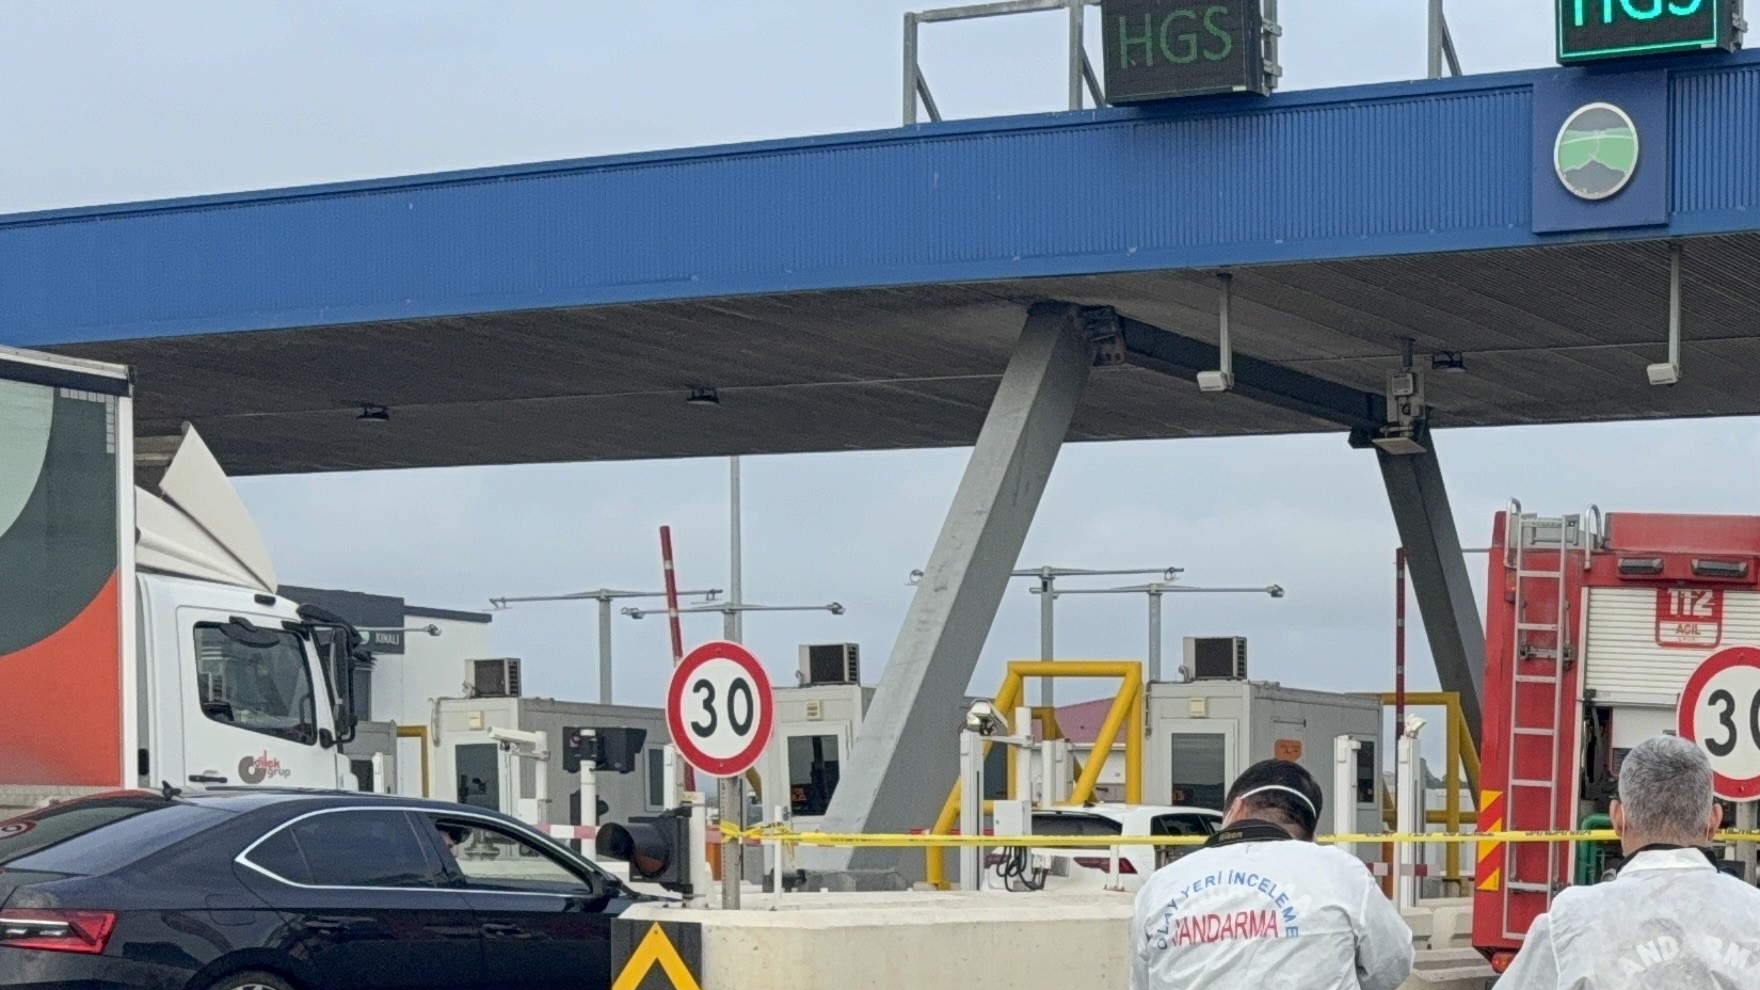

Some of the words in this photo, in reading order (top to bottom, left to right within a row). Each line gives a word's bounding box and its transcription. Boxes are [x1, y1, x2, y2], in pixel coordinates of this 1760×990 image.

[1117, 8, 1234, 69] HGS
[1667, 588, 1715, 616] 112
[690, 677, 755, 738] 30
[1157, 899, 1179, 950] OLAY
